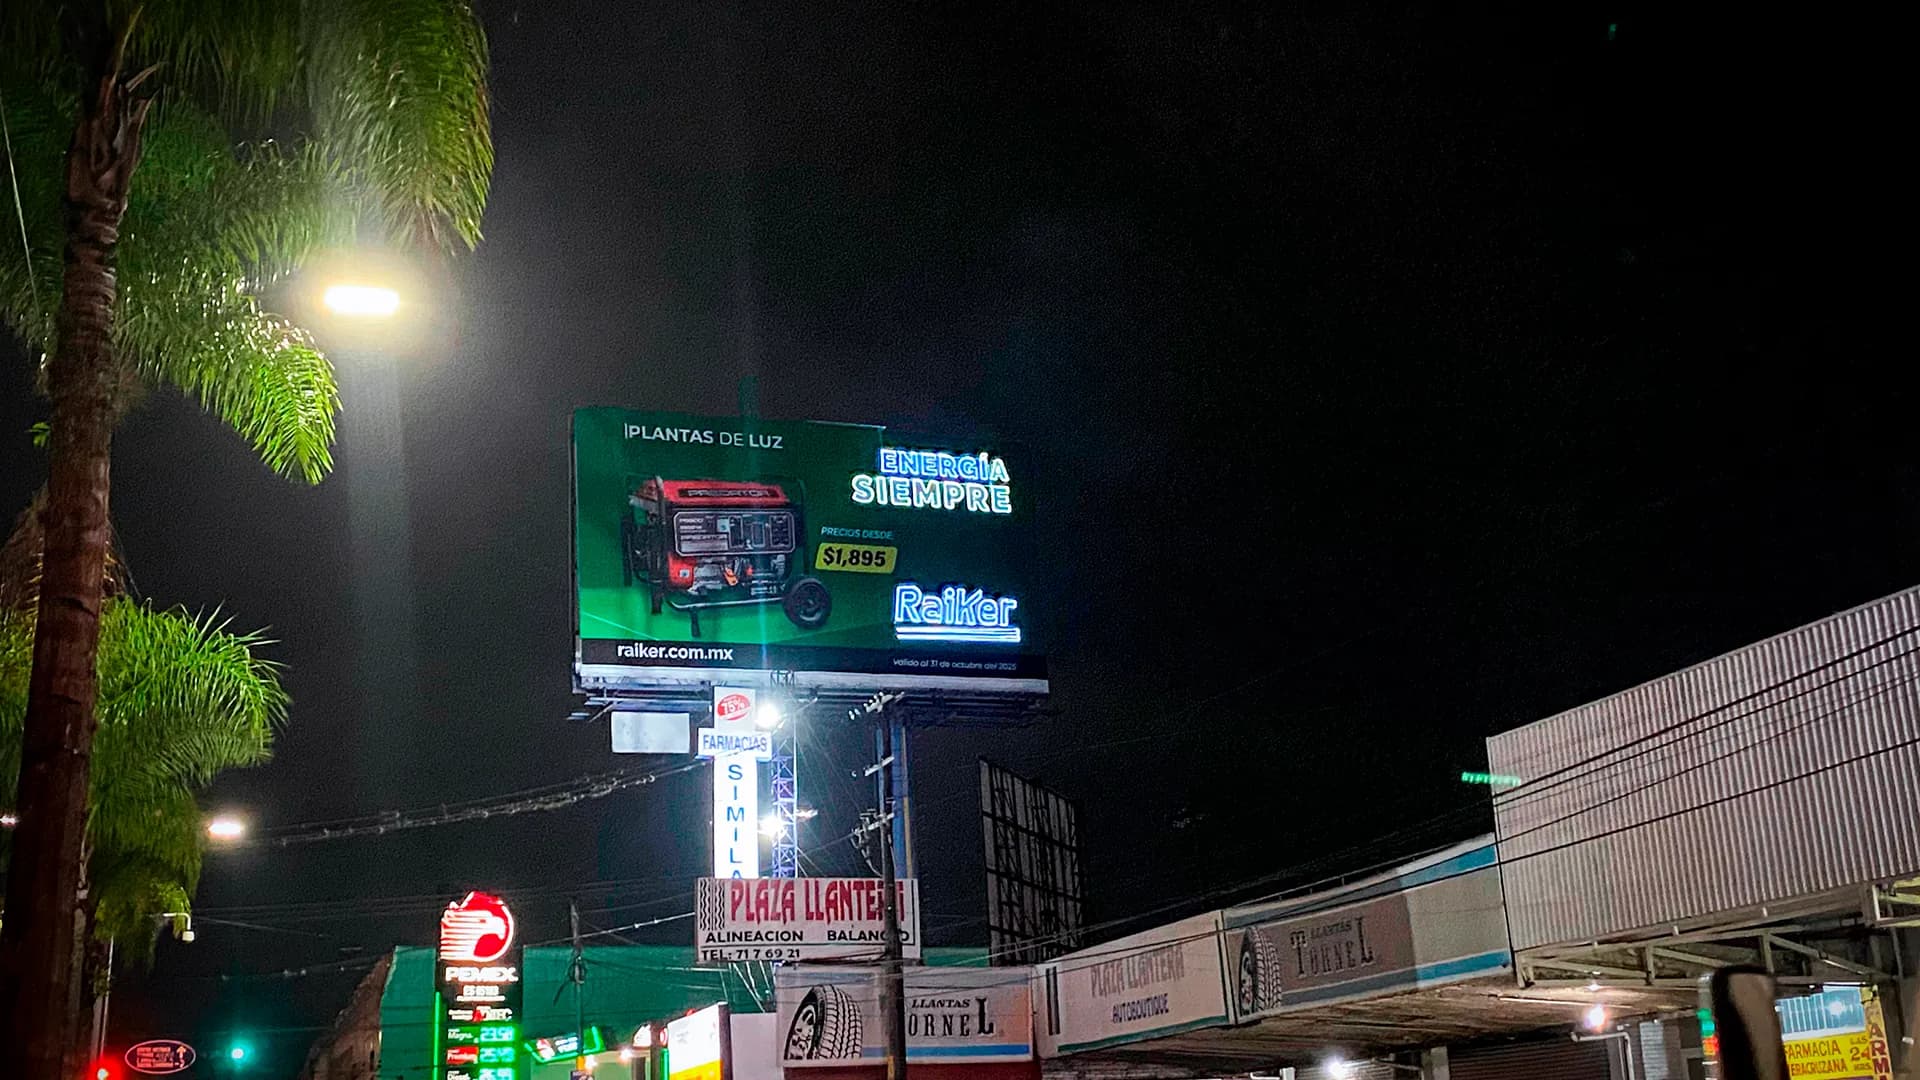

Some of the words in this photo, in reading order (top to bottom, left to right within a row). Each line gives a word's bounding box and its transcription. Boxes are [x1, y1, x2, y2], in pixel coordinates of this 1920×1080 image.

[628, 425, 714, 444] PLANTAS
[719, 432, 745, 446] DE
[749, 434, 783, 449] LUZ
[880, 448, 1011, 483] ENERGÍA
[852, 474, 1012, 513] SIEMPRE
[821, 527, 860, 538] PRECIOS
[862, 529, 893, 540] DESDE
[823, 546, 886, 567] $1,895
[617, 643, 733, 661] raiker.com.mx
[939, 660, 950, 668] de
[952, 662, 982, 670] octubre
[720, 697, 746, 715] 75%
[703, 734, 768, 752] FARMACIAS
[730, 880, 795, 925] PLAZA
[705, 930, 804, 943] ALINEACION
[827, 930, 910, 943] BALANCO
[701, 949, 732, 961] TEL:
[765, 949, 783, 959] 69
[788, 949, 800, 958] 21
[1290, 918, 1375, 976] TORNEL
[446, 967, 518, 982] PEMEX
[1090, 960, 1125, 998] PLAZA
[912, 999, 971, 1009] LLANTAS
[1112, 993, 1169, 1024] AUTOBOUTIQUE
[908, 997, 994, 1037] ORNEL
[1850, 1046, 1870, 1061] 24
[1791, 1058, 1848, 1076] ERACRUZANA
